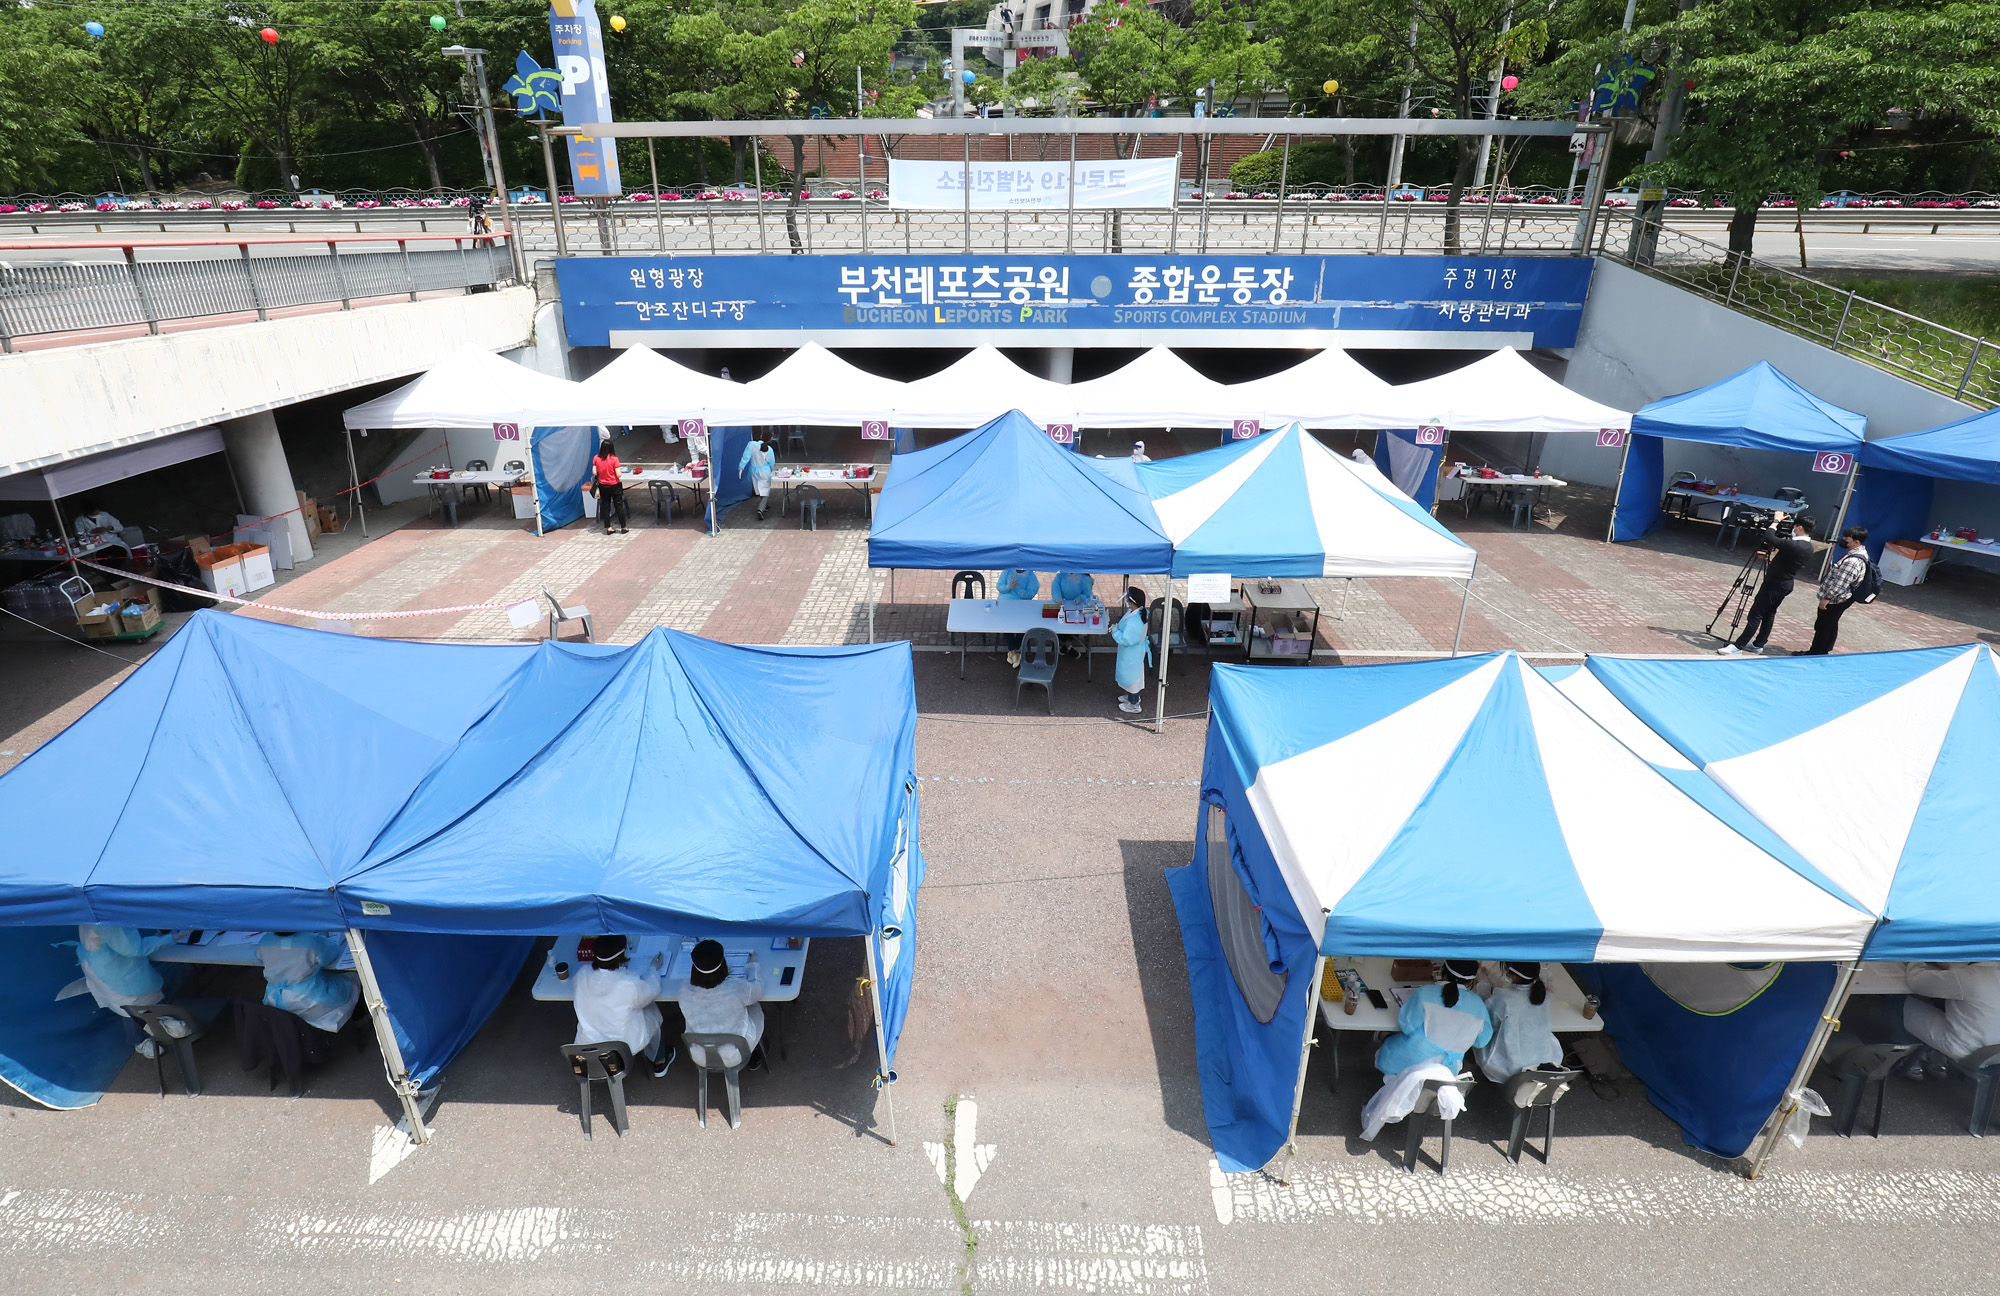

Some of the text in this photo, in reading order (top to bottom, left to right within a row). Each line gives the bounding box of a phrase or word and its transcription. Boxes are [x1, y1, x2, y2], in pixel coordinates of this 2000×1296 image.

[554, 24, 583, 35] 주차장
[558, 38, 582, 46] Parking
[557, 55, 590, 95] P
[629, 267, 704, 289] 원형광장
[837, 265, 1069, 305] 부천레포츠공원
[1128, 264, 1294, 306] 종합운동장
[1443, 268, 1517, 290] 주경기장
[843, 306, 1068, 323] BUCHEON LEPORTS PARK
[1113, 309, 1307, 323] SPORTS COMPLEX STADIUM
[1438, 302, 1531, 323] 차량관리과
